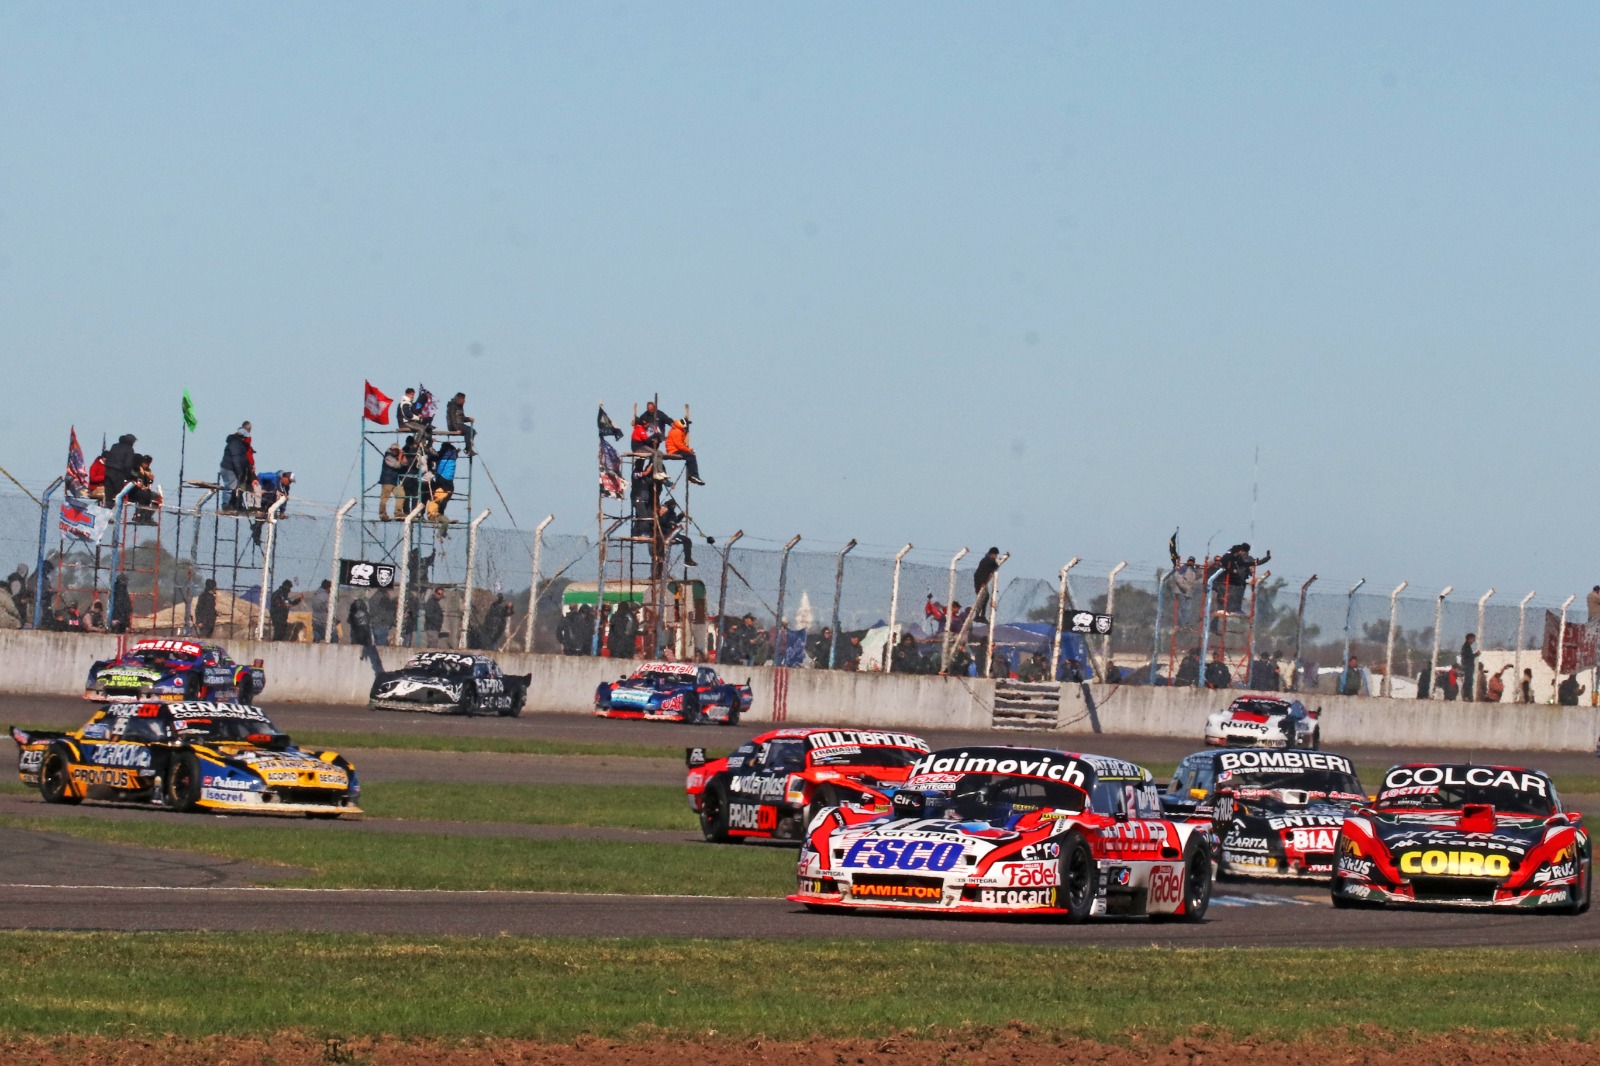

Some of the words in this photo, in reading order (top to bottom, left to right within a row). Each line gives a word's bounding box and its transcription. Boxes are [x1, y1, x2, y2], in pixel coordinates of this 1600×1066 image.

[167, 702, 264, 716] RENAULT
[808, 732, 932, 754] MULTIBANDAS
[909, 752, 1085, 787] Haimovich
[1220, 751, 1352, 774] BOMBIERI
[1380, 785, 1439, 800] LOCTITE
[1385, 767, 1547, 798] COLCAR
[728, 803, 777, 829] PRADECON
[841, 838, 966, 871] ESCO
[1223, 838, 1268, 849] CLARITA
[1428, 839, 1526, 855] Kappa
[1001, 861, 1057, 887] Fadel
[1400, 850, 1511, 877] COIRO
[852, 884, 941, 898] HAMILTON
[981, 887, 1050, 904] Brocart
[1149, 866, 1185, 905] Fadel
[1538, 890, 1567, 905] PUMA
